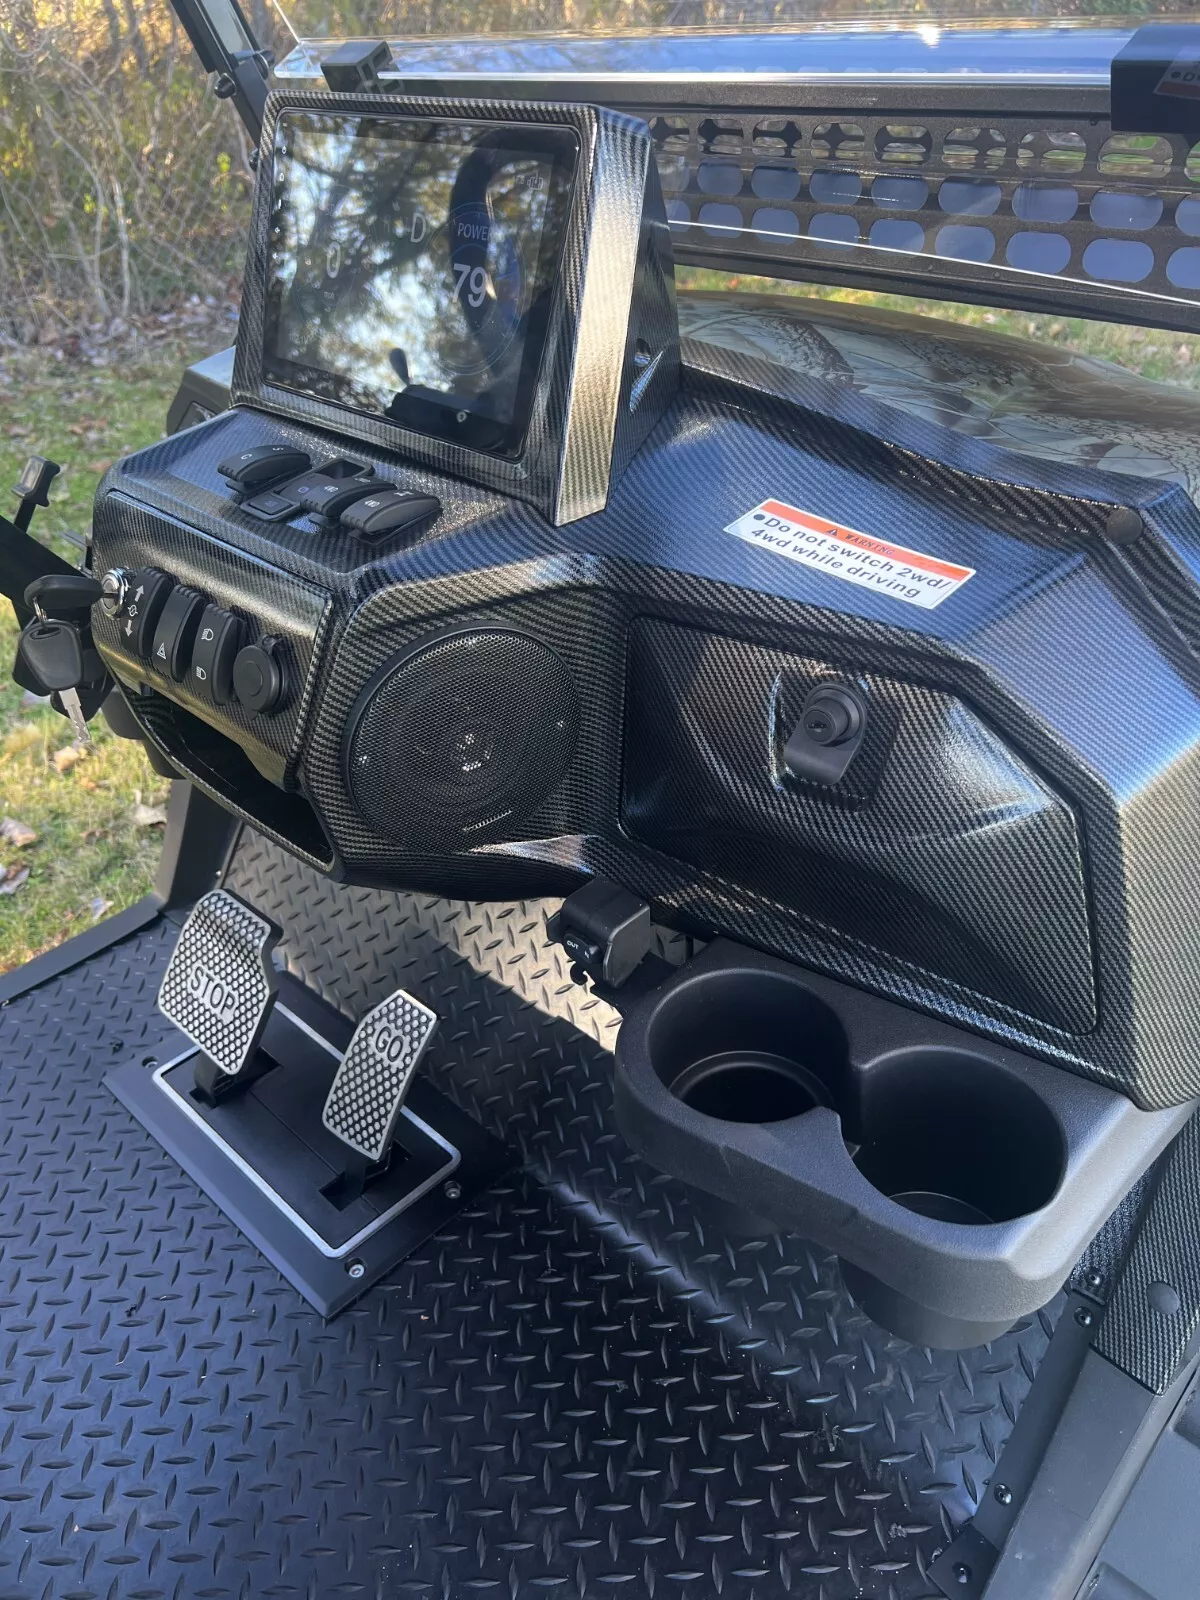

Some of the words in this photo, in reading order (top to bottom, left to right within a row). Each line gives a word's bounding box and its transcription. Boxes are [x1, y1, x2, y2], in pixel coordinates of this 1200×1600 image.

[410, 212, 427, 243] D
[452, 263, 487, 308] 79
[751, 529, 792, 548] 4wd
[792, 545, 843, 569] while
[846, 566, 921, 599] driving
[764, 518, 791, 533] Do
[793, 531, 827, 547] not
[827, 543, 894, 572] switch
[897, 567, 952, 590] 2wd/
[844, 533, 895, 556] WARNING
[190, 965, 237, 1016] STOP
[375, 1022, 405, 1063] GO
